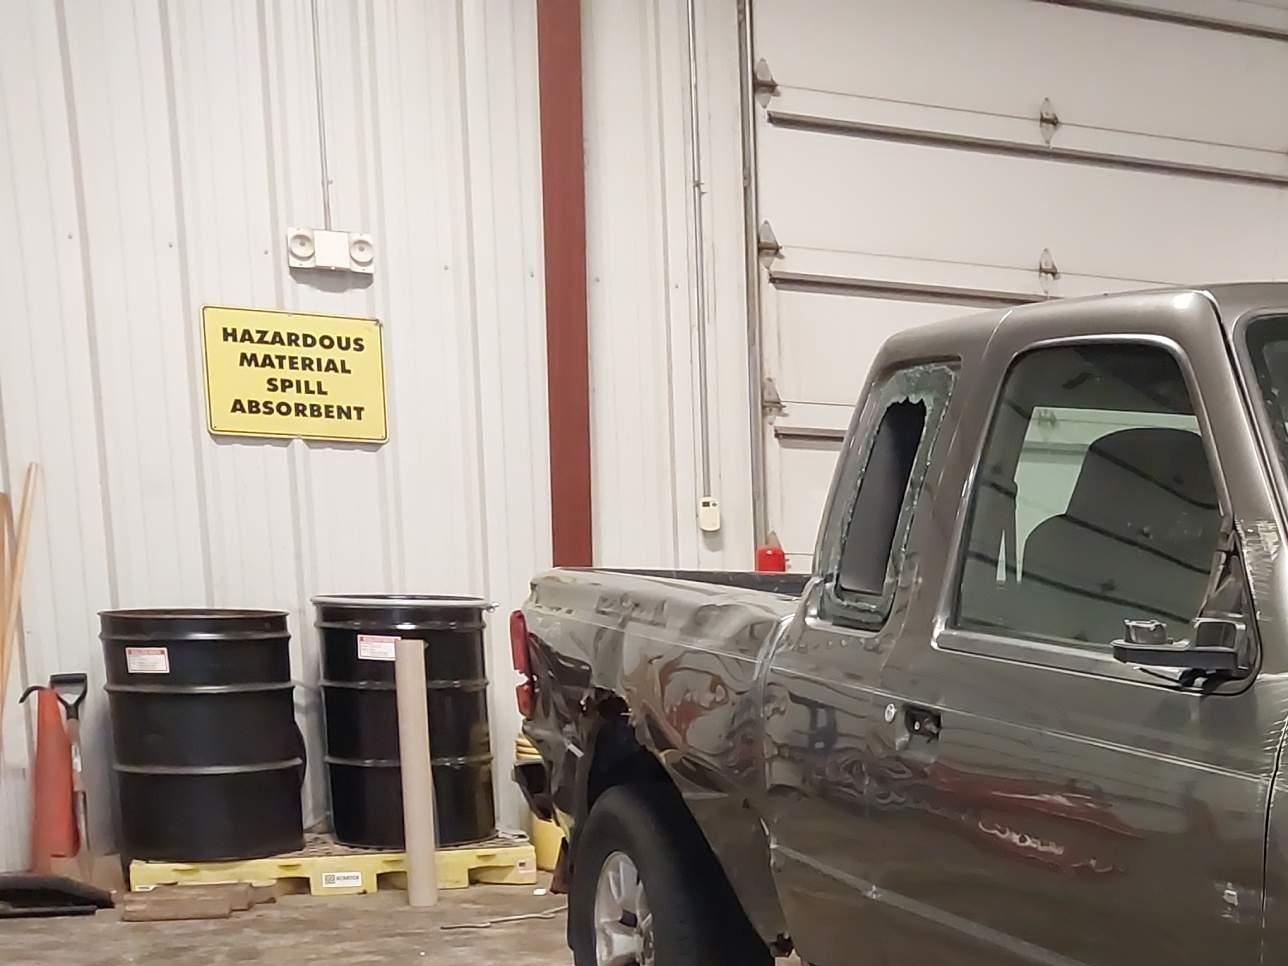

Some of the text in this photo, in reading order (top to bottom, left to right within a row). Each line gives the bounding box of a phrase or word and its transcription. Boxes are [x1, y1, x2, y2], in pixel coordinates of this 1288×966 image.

[222, 327, 365, 352] HAZARDOUS
[239, 352, 352, 374] MATERIAL
[266, 377, 328, 396] SPILL
[230, 399, 365, 420] ABSORBENT
